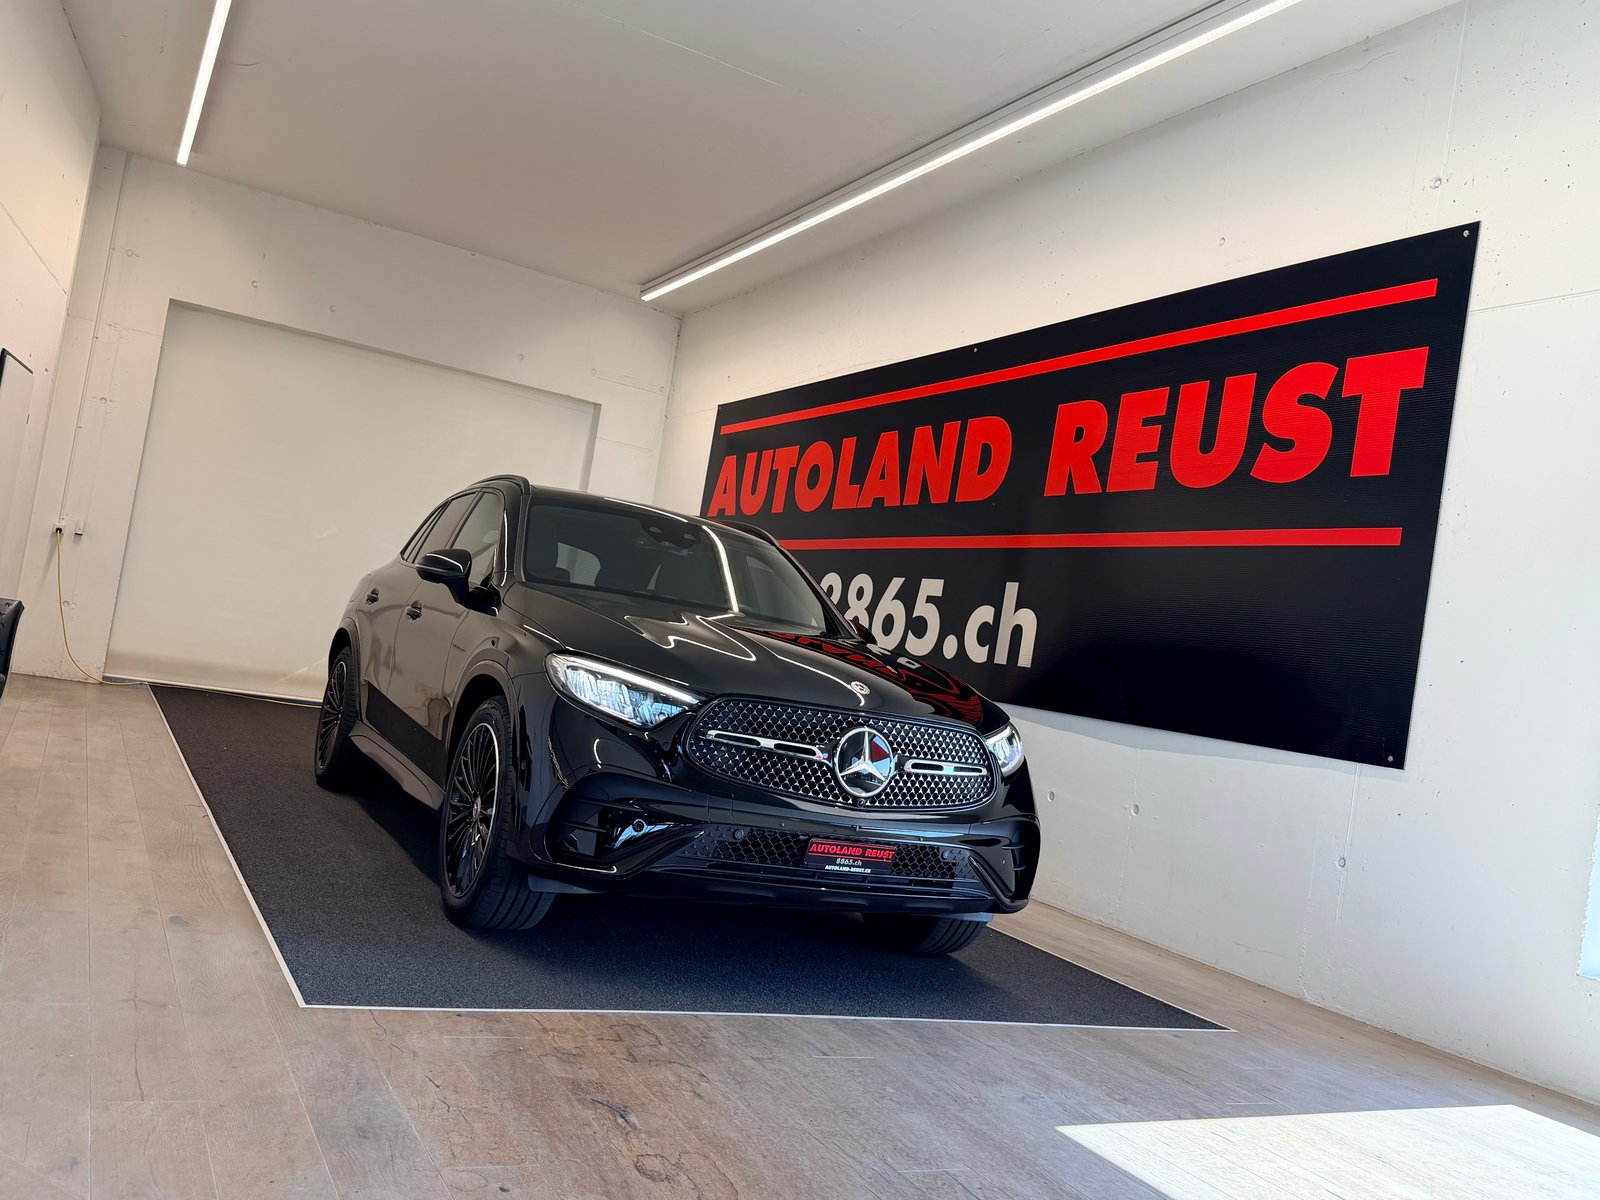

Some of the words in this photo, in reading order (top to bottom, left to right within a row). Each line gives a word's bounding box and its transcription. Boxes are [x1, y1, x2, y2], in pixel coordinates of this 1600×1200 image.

[707, 415, 1013, 518] AUTOLAND
[1043, 346, 1430, 497] REUST
[809, 844, 862, 855] AUTOLAND
[865, 848, 895, 859] REUST
[836, 858, 862, 866] 8865.ch
